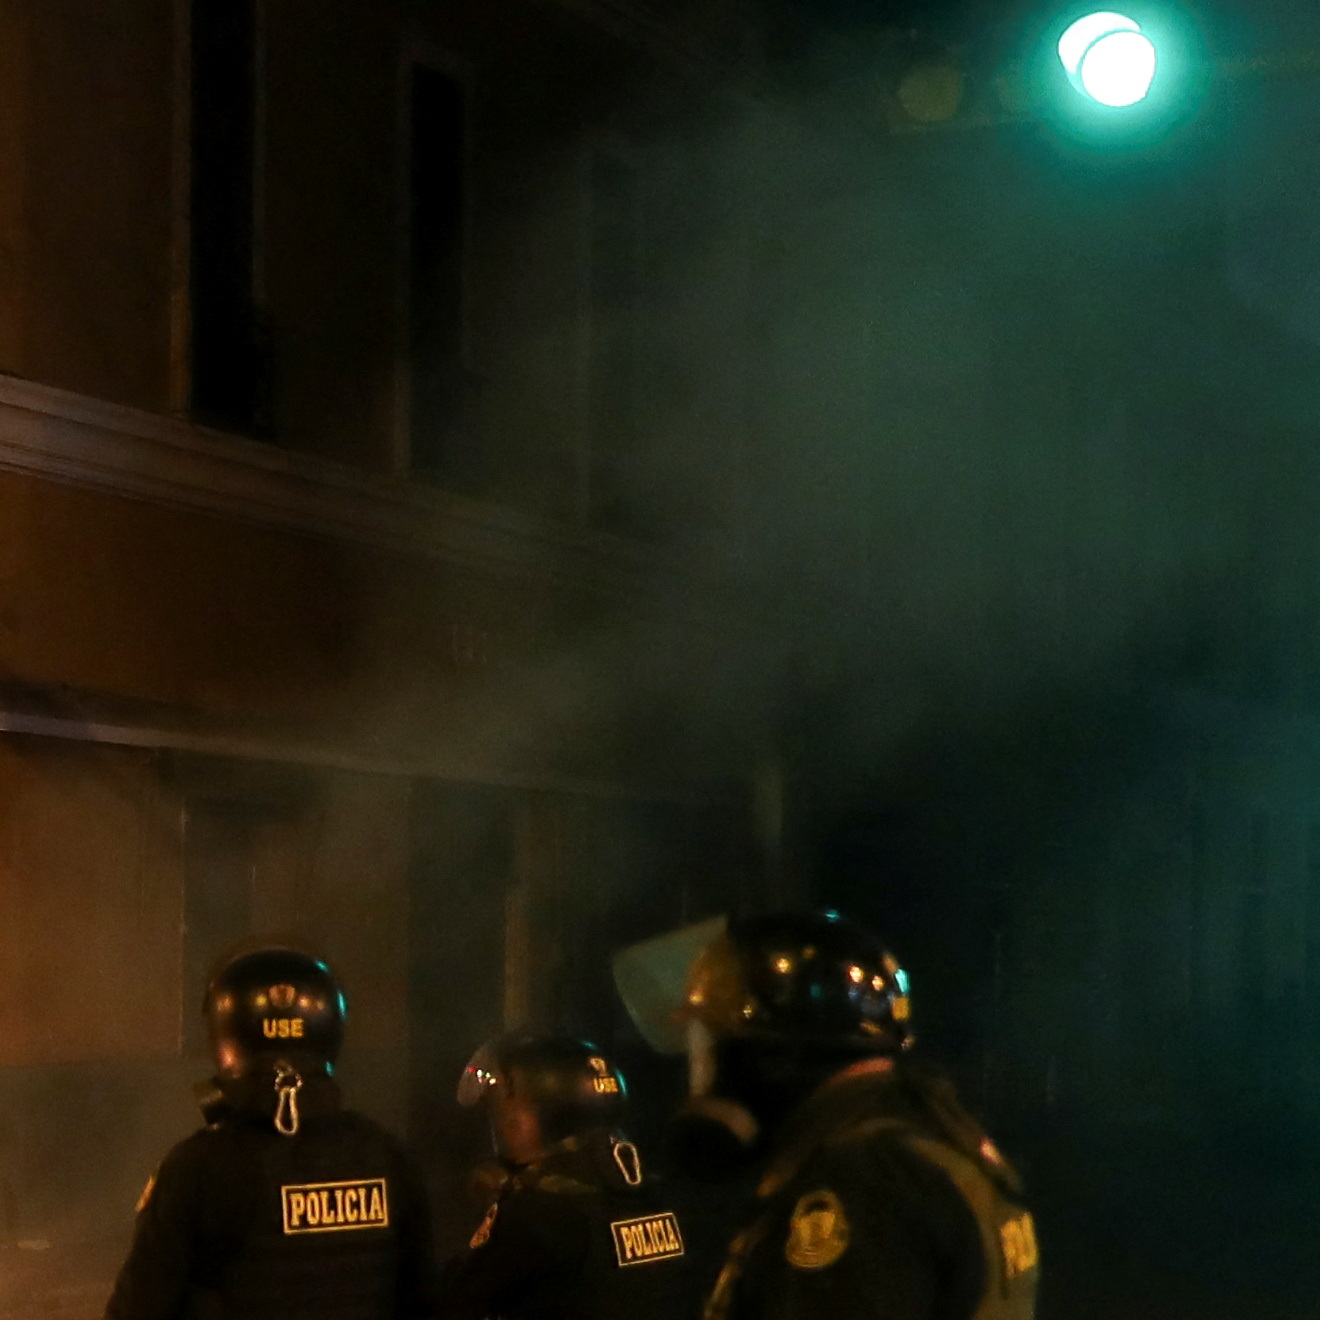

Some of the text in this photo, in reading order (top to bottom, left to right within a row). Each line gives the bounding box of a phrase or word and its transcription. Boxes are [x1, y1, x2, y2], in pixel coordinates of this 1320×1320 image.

[263, 1018, 305, 1039] USE
[593, 1077, 619, 1093] USE
[289, 1186, 384, 1227] POLICIA
[620, 1218, 680, 1259] POLICIA
